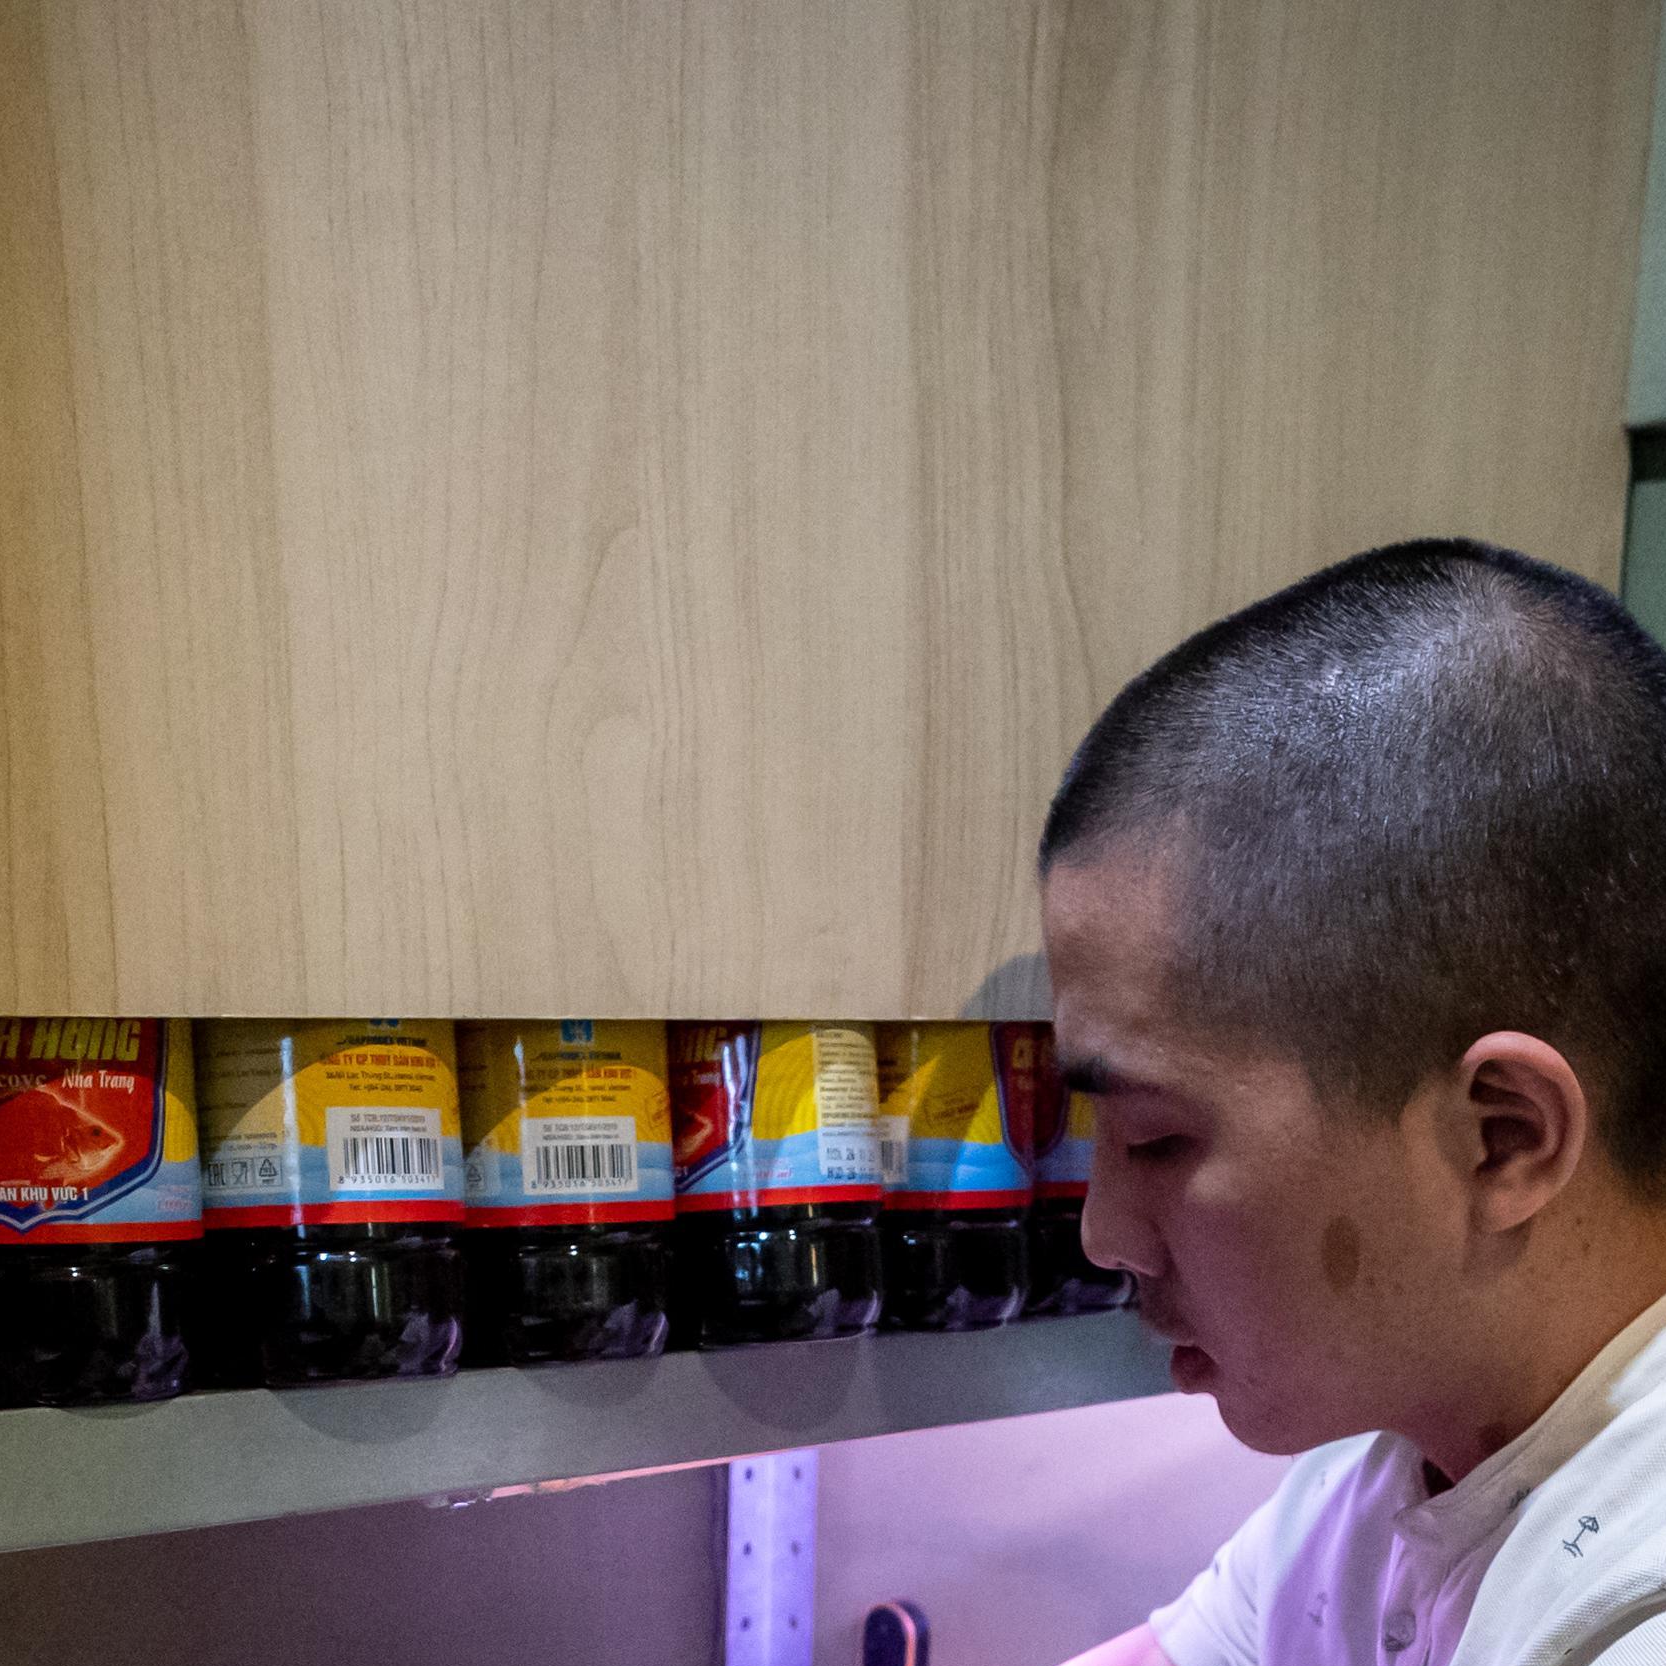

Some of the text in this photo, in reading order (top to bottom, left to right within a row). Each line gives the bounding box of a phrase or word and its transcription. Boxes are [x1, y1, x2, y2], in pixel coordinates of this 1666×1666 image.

[62, 1068, 136, 1094] Nha Trang
[20, 1187, 49, 1201] KHU
[81, 1187, 89, 1201] 1
